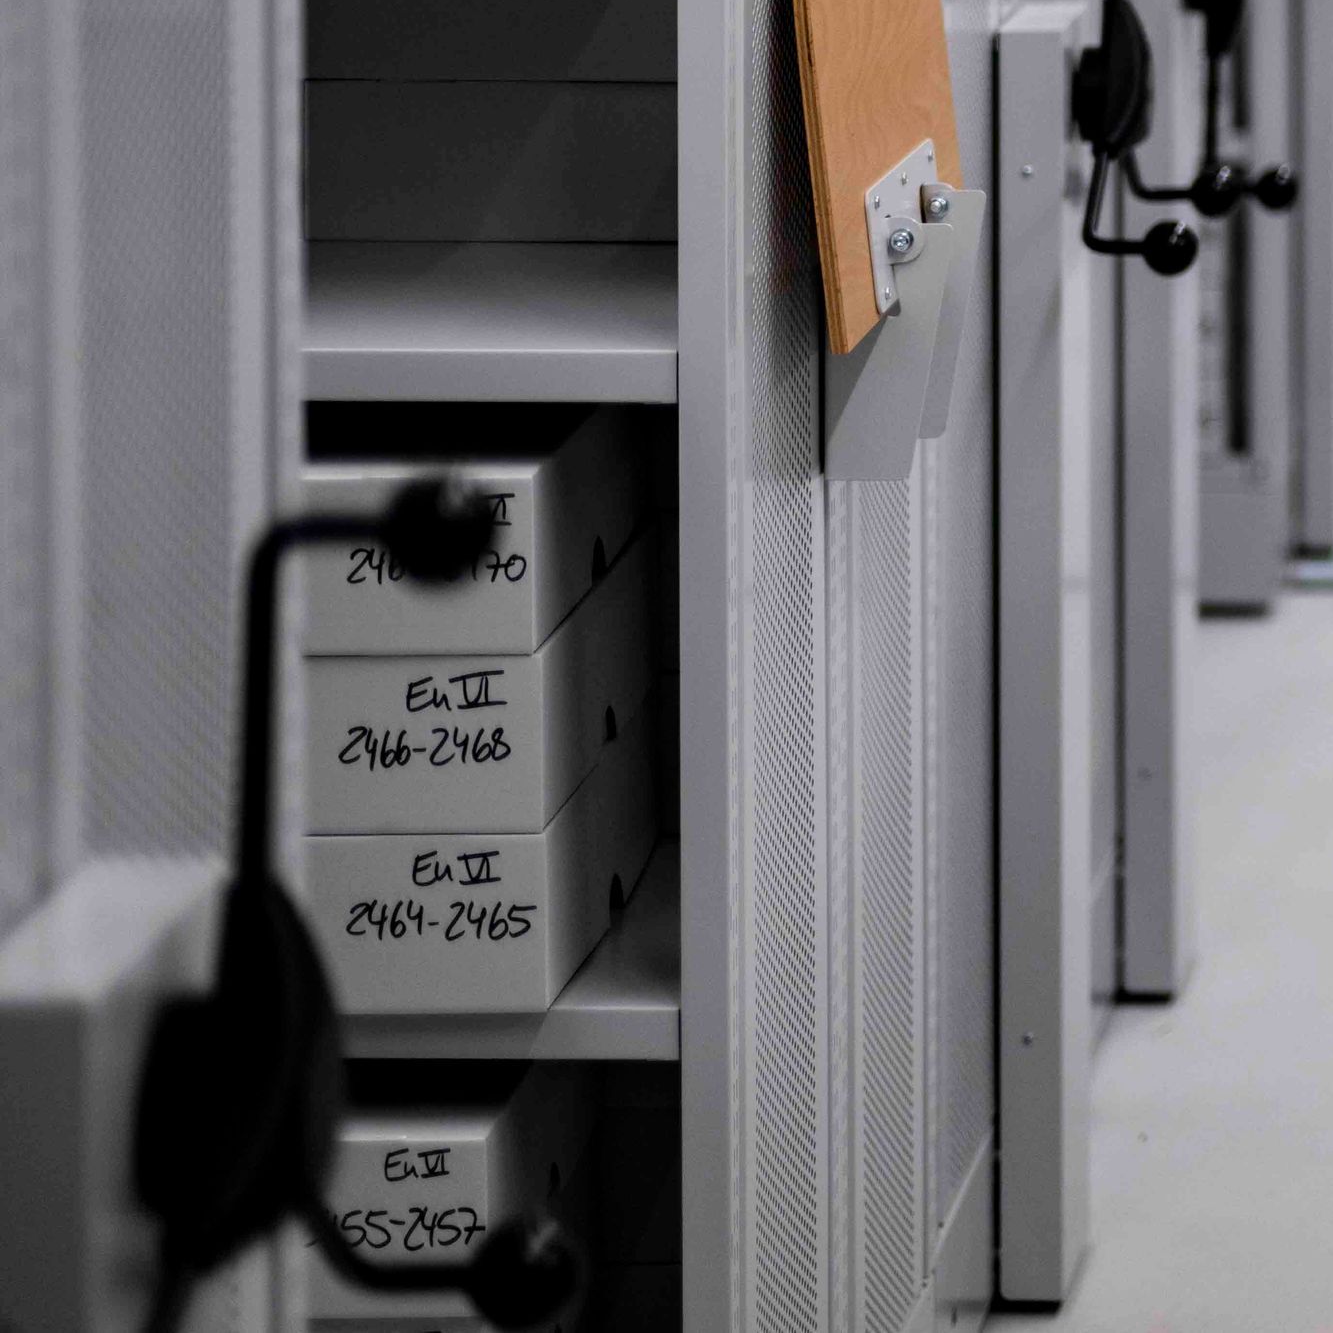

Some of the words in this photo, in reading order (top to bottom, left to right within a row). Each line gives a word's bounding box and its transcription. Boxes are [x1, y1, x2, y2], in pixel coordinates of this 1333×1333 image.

[447, 670, 507, 711] VI
[338, 726, 511, 771] 2466-2468
[457, 851, 501, 885] VI
[346, 899, 537, 941] 2464-2465
[417, 1148, 450, 1179] VI
